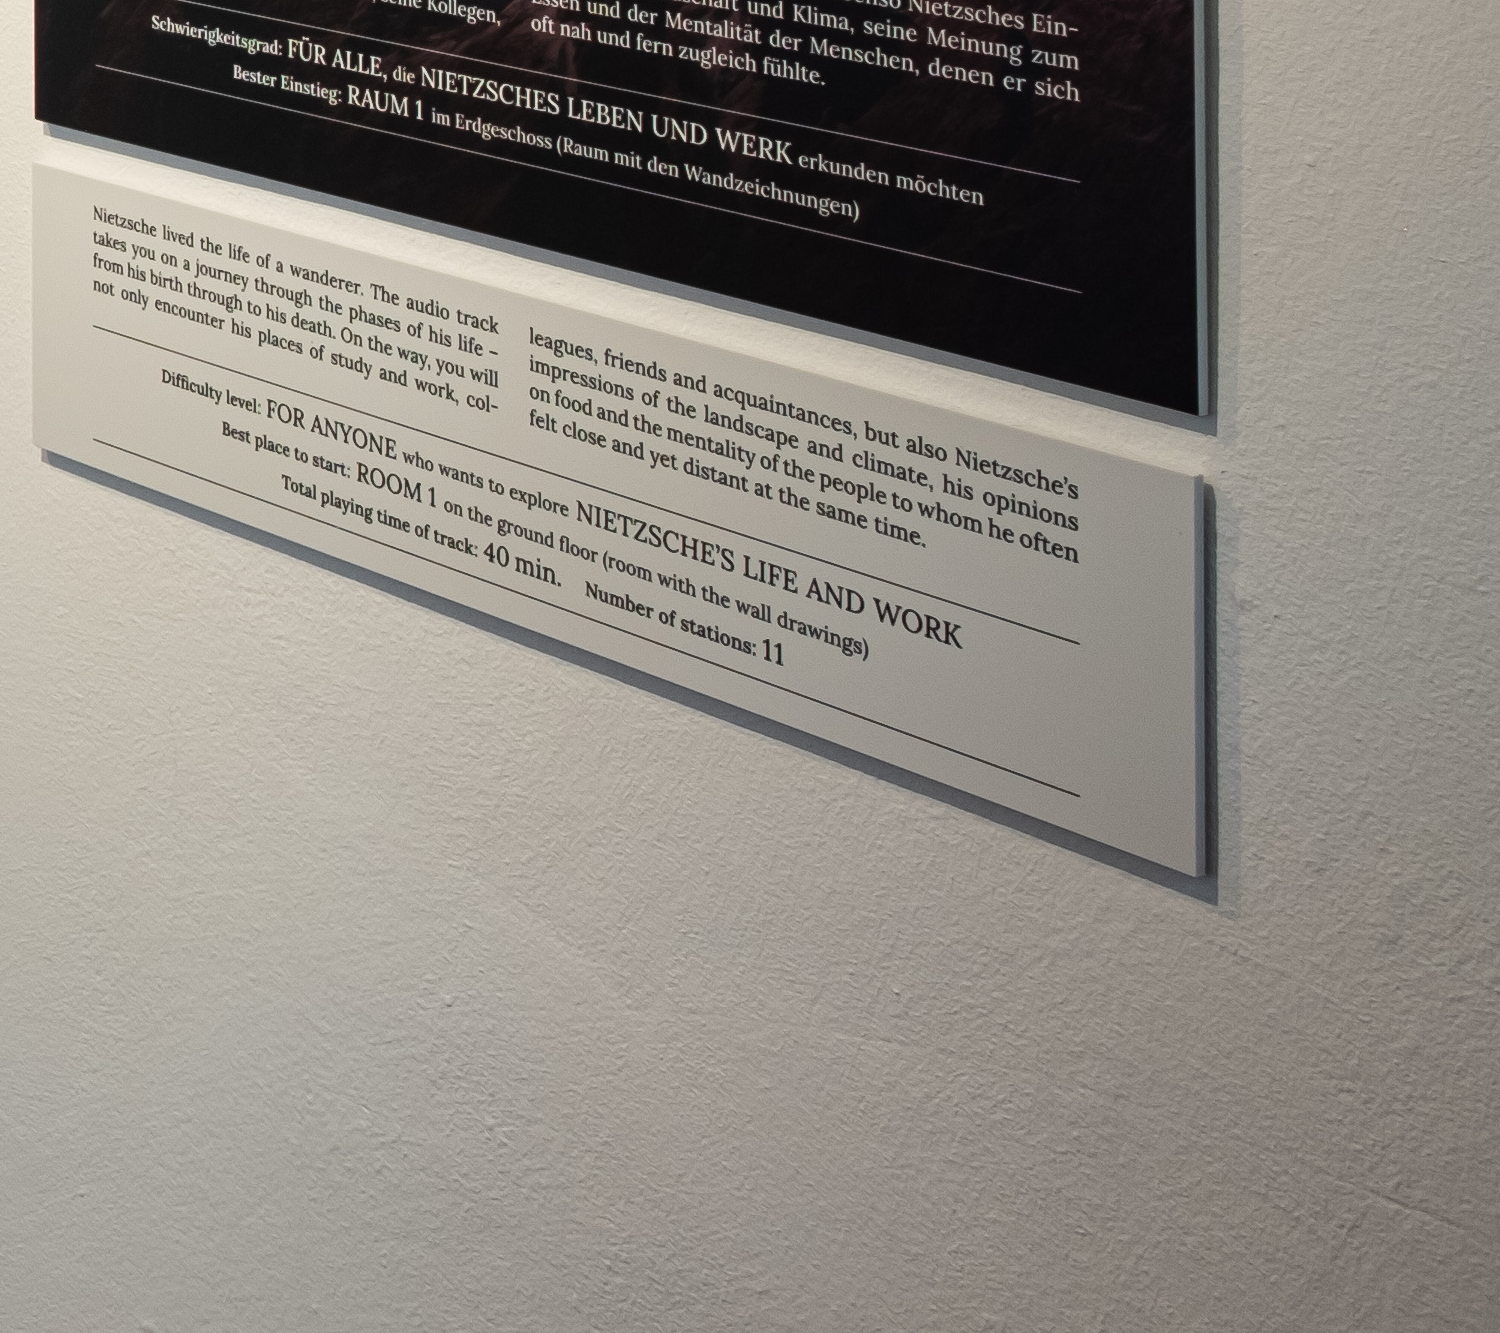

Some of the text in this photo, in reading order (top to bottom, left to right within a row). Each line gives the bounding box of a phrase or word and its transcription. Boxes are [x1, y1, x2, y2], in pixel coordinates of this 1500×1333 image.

[150, 13, 985, 206] Schwierigkeitsgrad: FÜR ALLE, die NIETZSCHES LEBEN UND WERK erkunden möchten
[232, 63, 860, 223] Bester Einstieg: RAUM 1 im Erdgeschoss (Raum mit den Wandzeichnungen)
[160, 367, 963, 650] Difficulty level: FOR ANYONE who wants to explore NIETZSCHE’S LIFE AND WORK
[221, 420, 870, 662] Best place to start: ROOM 1 on the ground floor (room with the wall drawings)
[280, 473, 784, 667] Total playing time of track: 40 min. Number of stations: 11
